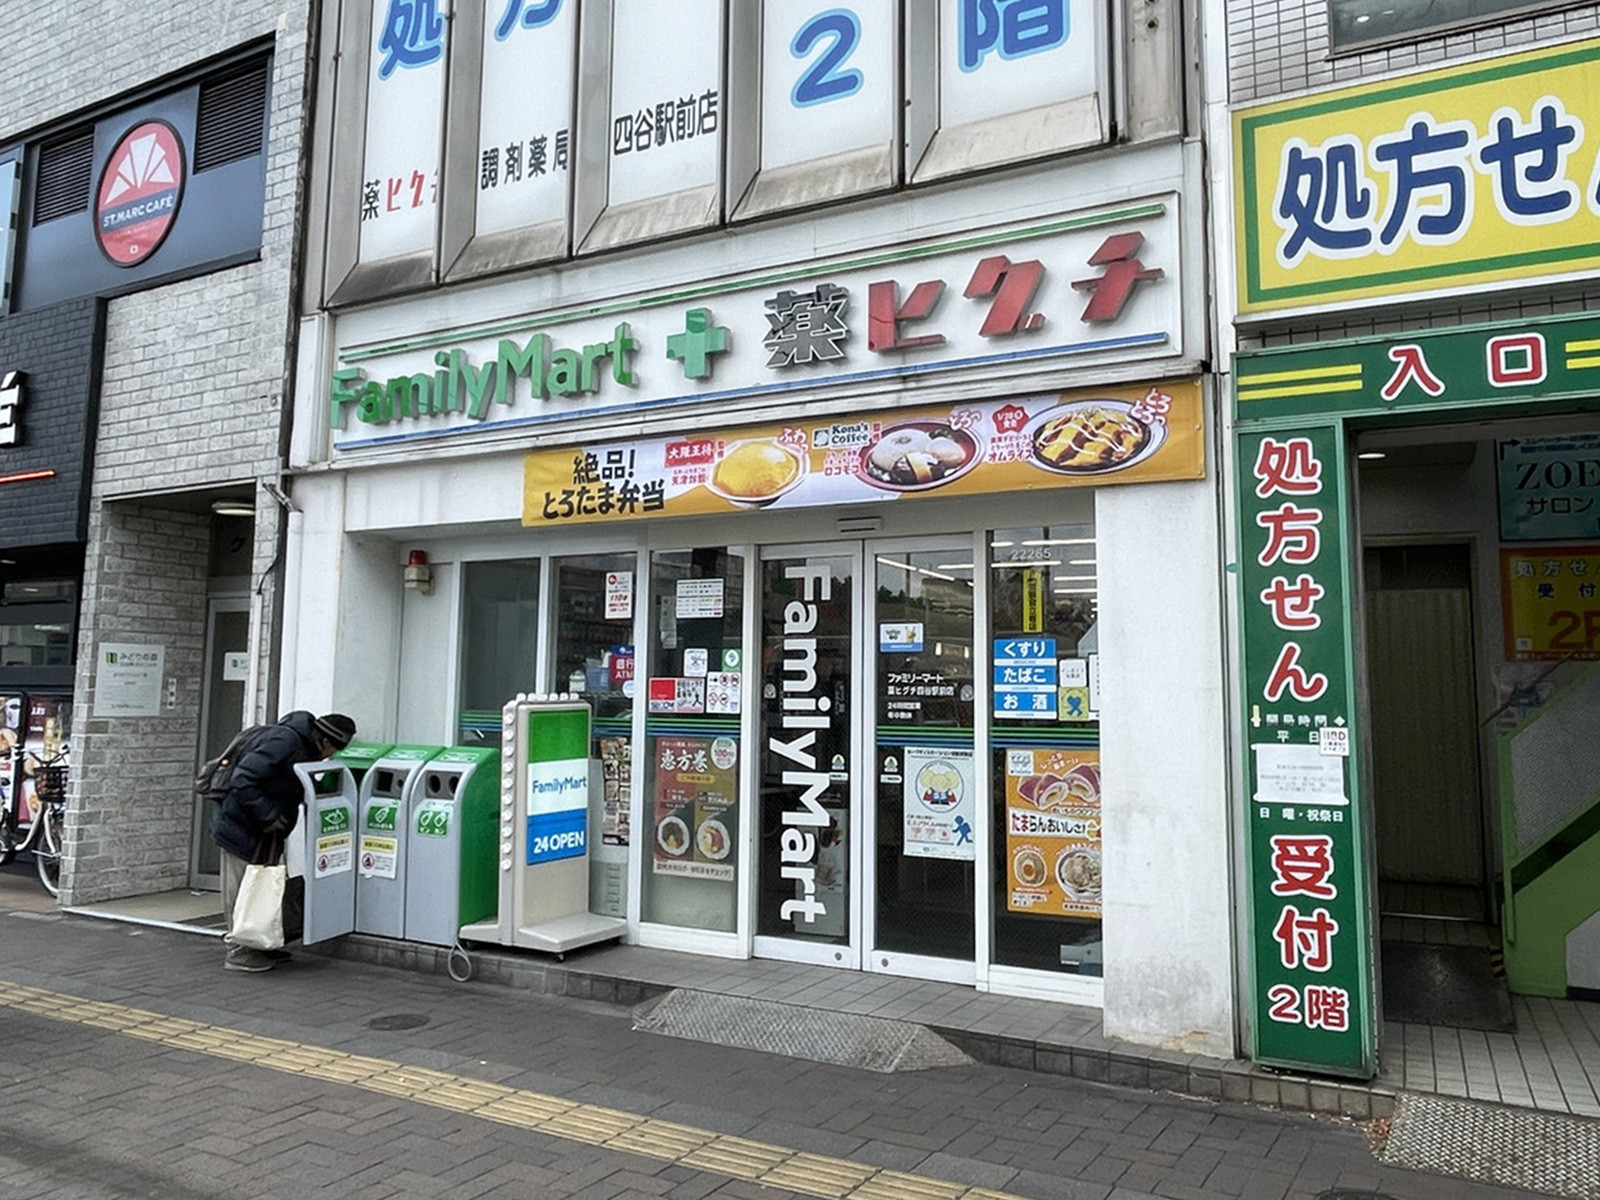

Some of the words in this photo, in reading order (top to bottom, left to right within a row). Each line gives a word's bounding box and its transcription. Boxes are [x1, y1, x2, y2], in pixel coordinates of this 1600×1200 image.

[613, 89, 718, 155] 四谷駅前店
[1276, 102, 1600, 262] 処方せ
[763, 231, 1166, 370] 薬ヒグチ
[331, 321, 640, 429] FamilyMart
[1380, 332, 1548, 401] 入口
[831, 433, 869, 445] Coffee
[832, 422, 869, 435] Kona's
[572, 449, 637, 485] 絶品!
[988, 450, 1034, 463] オムライス
[541, 478, 665, 520] とろたま弁当
[1526, 497, 1595, 516] サロン
[1254, 437, 1328, 702] 処方せん
[1515, 559, 1600, 578] 処方せ
[1003, 642, 1046, 658] くすり
[887, 673, 945, 684] ファミリーマート
[1003, 667, 1047, 683] たばこ
[1003, 693, 1048, 710] お酒
[768, 565, 831, 924] FamilyMart
[532, 775, 587, 795] FamilyMart
[549, 830, 585, 851] OPEN
[1270, 834, 1339, 973] 受付
[1267, 983, 1350, 1032] 2階
